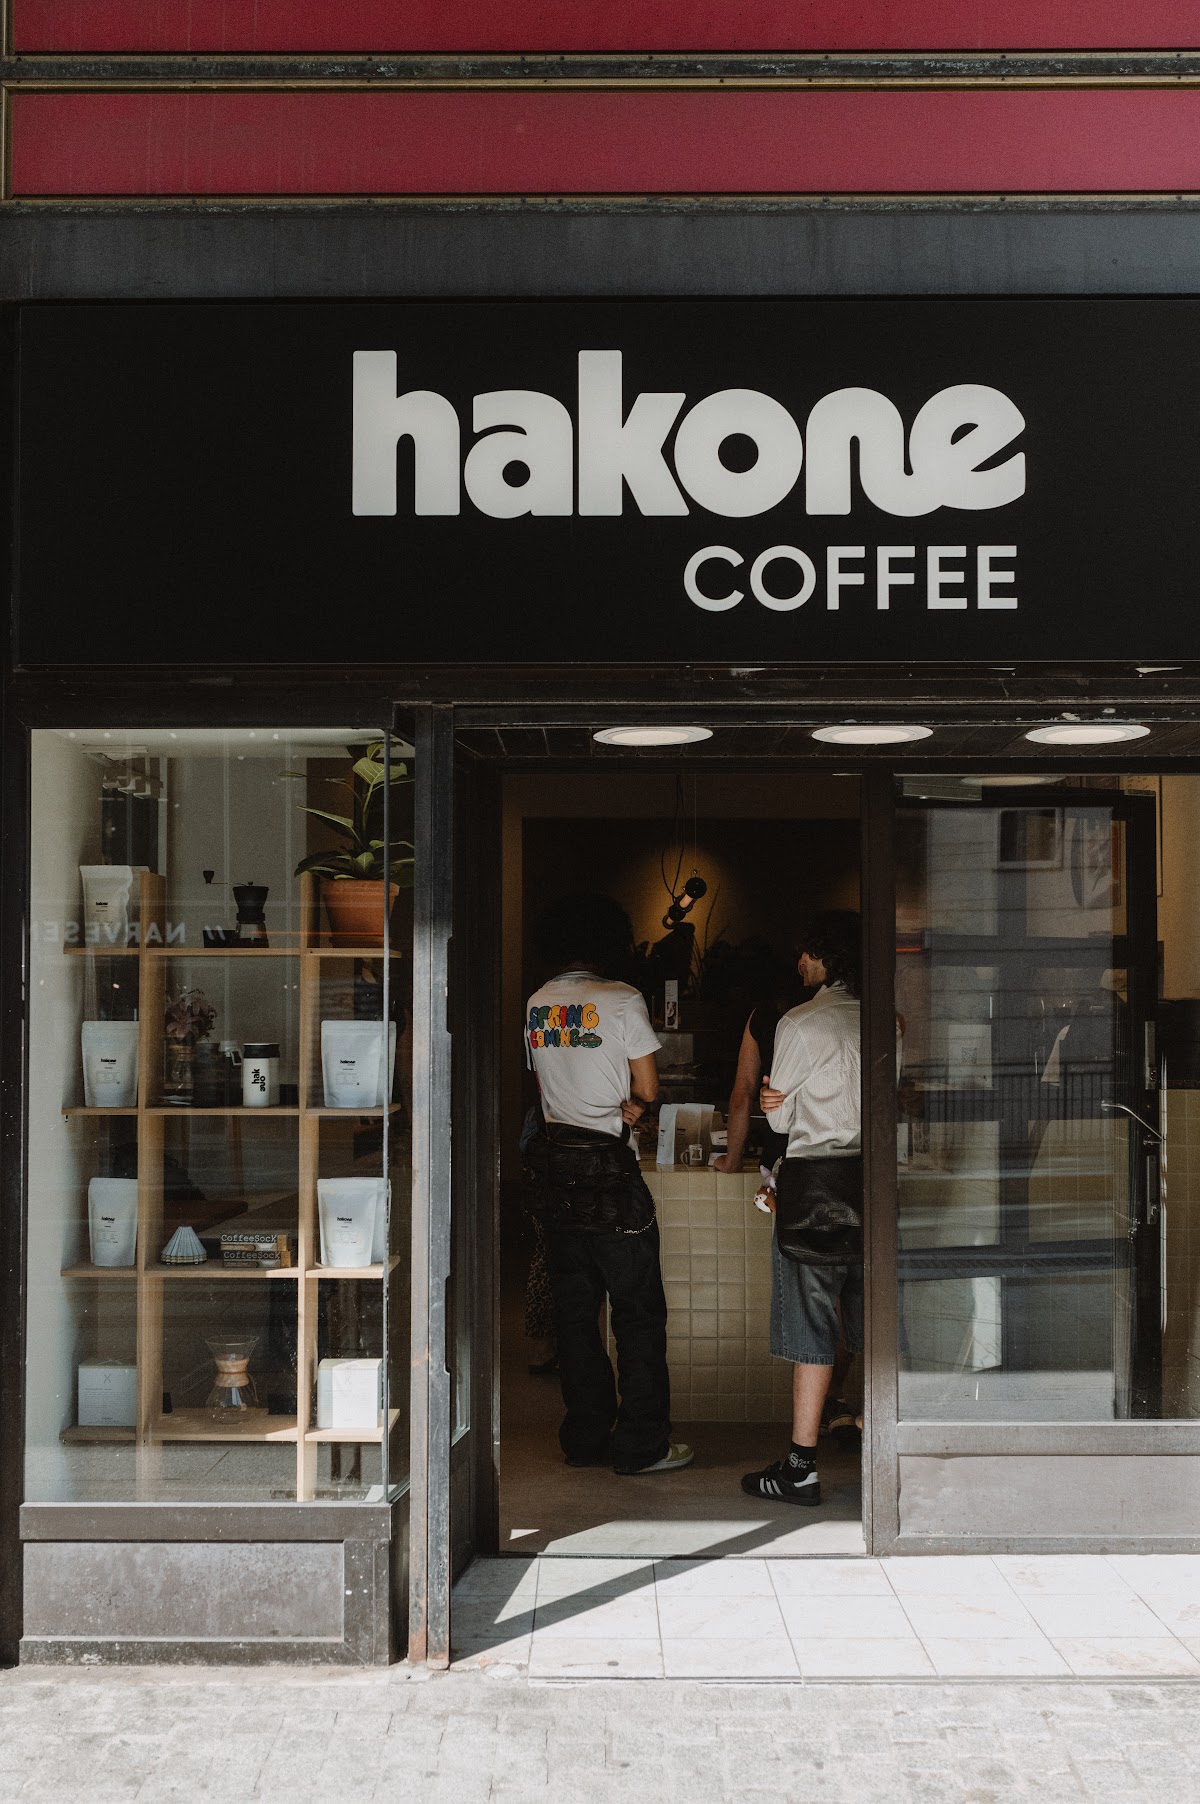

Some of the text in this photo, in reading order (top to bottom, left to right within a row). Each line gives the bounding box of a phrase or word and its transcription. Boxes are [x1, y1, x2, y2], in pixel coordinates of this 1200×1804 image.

[352, 349, 1026, 519] hakone
[683, 545, 1018, 612] COFFEE
[529, 1003, 599, 1031] SPRING
[530, 1029, 580, 1049] COMING
[251, 1068, 260, 1085] hak
[221, 1234, 277, 1243] CoffeeSock
[223, 1251, 280, 1260] CoffeeSock
